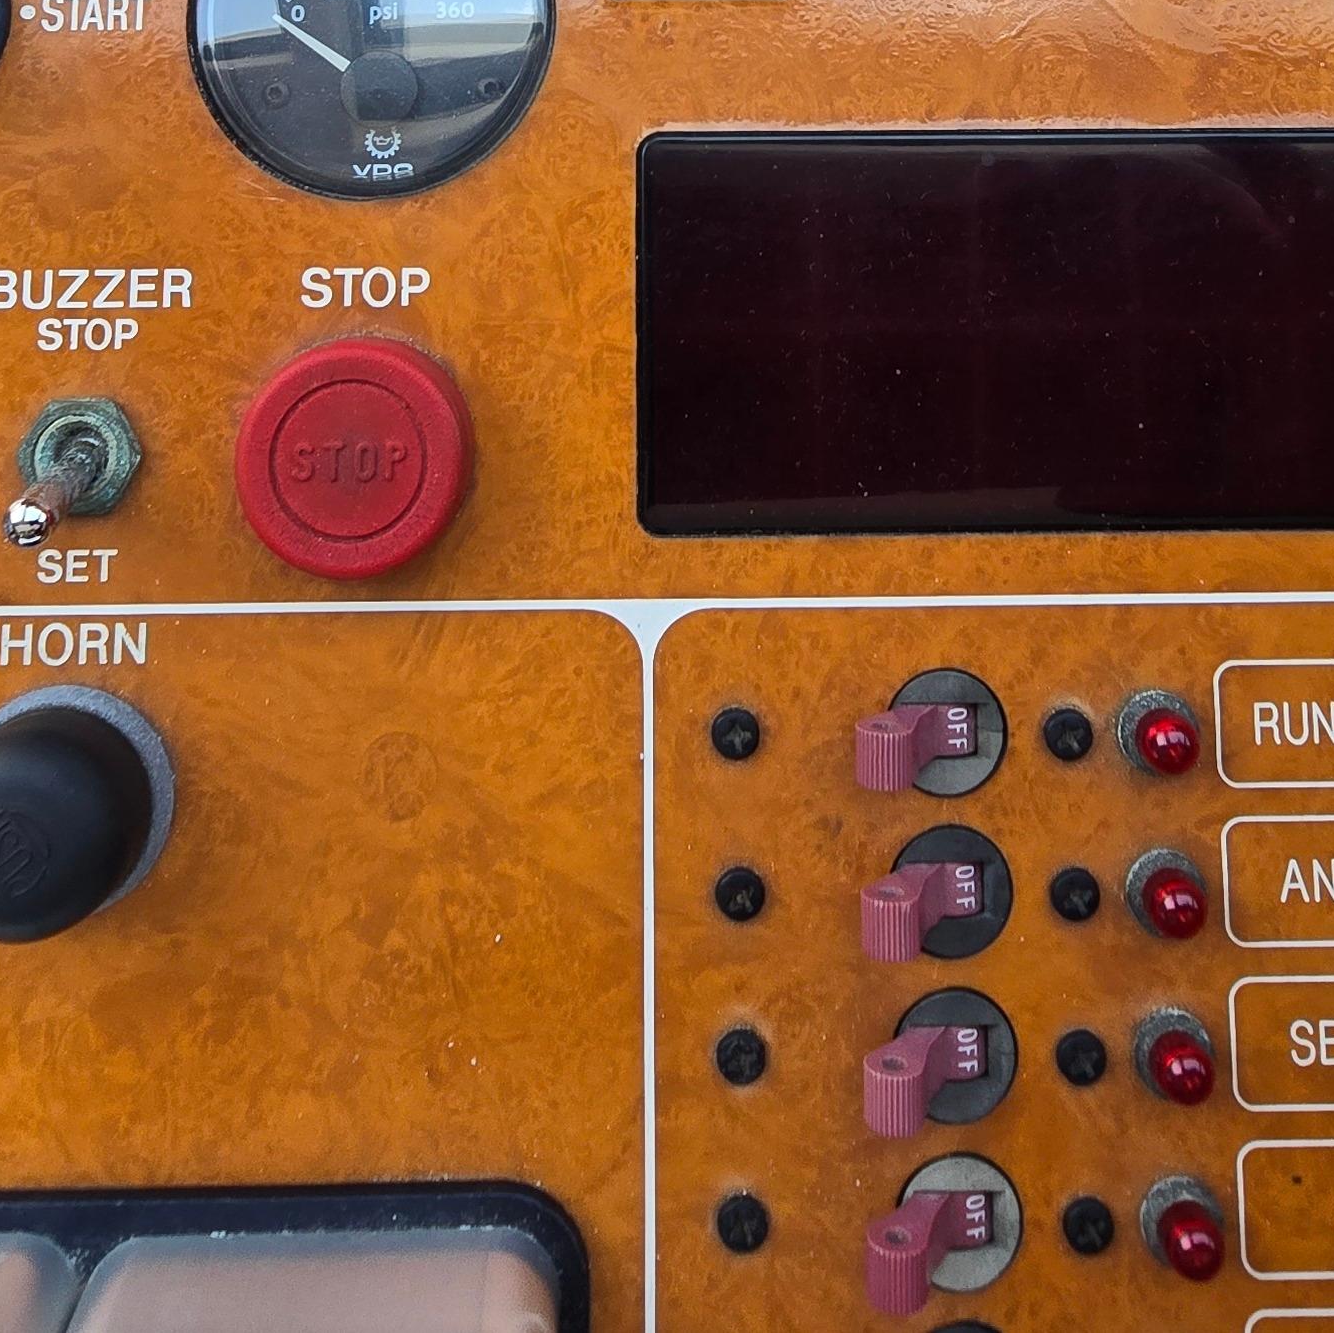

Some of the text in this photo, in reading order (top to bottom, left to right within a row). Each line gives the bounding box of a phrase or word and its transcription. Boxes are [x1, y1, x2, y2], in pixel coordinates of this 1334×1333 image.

[291, 5, 305, 23] 0
[369, 3, 398, 26] psi
[436, 1, 475, 20] 360
[300, 266, 431, 310] STOP
[36, 317, 140, 353] STOP
[292, 439, 409, 484] STOP
[36, 548, 119, 584] SET
[946, 706, 969, 752] OFF
[954, 864, 977, 911] OFF
[956, 1027, 980, 1074] OFF
[964, 1193, 987, 1241] OFF
